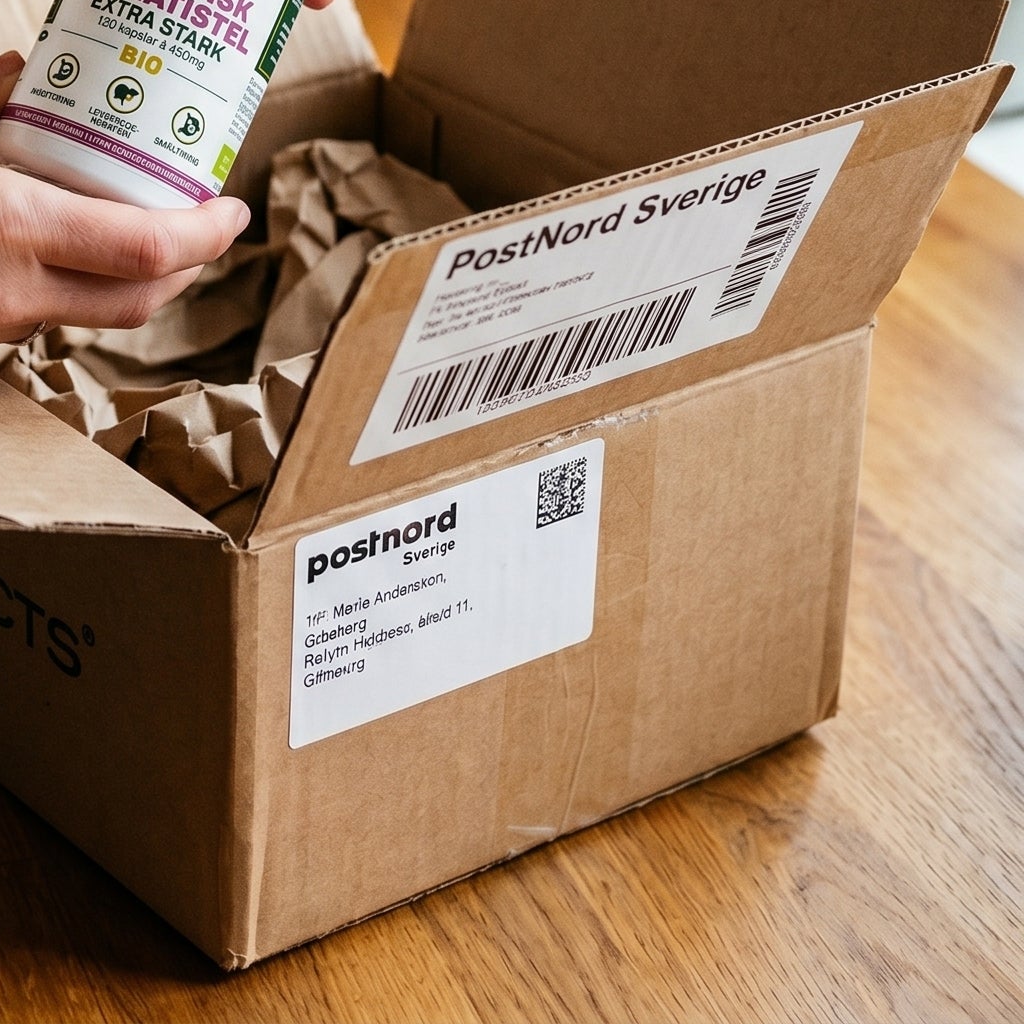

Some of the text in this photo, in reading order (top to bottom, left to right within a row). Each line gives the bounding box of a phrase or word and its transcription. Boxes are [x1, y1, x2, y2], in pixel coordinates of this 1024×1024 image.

[118, 20, 159, 46] kapslar
[169, 45, 206, 71] 450mg
[118, 43, 163, 76] BIO
[159, 17, 227, 63] STARK
[445, 166, 769, 280] PostNord Sverige
[307, 502, 458, 584] postnord
[403, 538, 456, 566] Sverige
